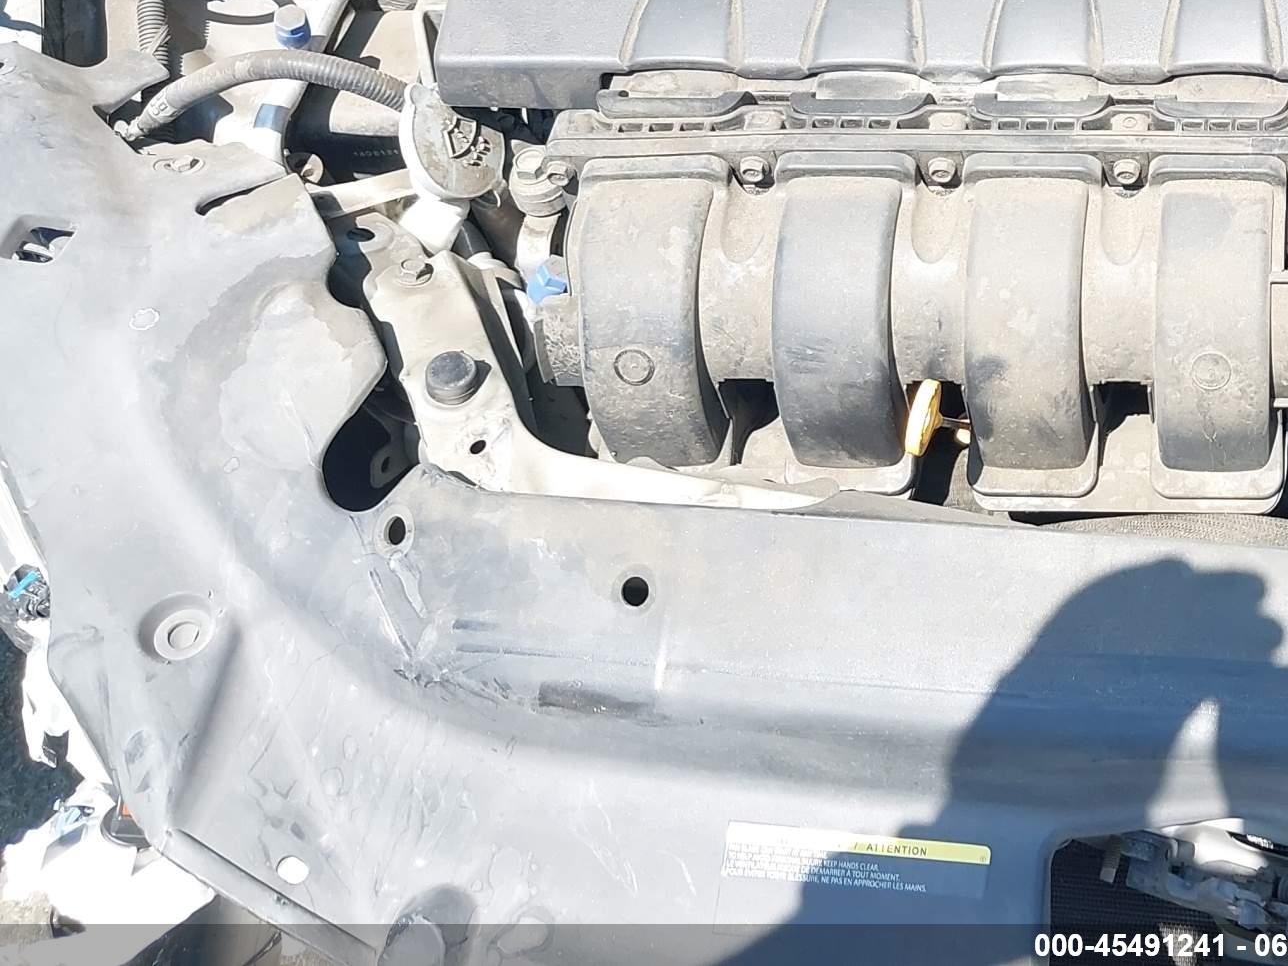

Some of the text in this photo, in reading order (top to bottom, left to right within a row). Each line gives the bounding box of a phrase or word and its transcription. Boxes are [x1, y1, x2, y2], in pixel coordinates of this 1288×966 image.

[839, 860, 859, 869] HANDS
[852, 870, 869, 879] TOUT
[831, 877, 843, 885] PAS
[892, 881, 904, 891] LES
